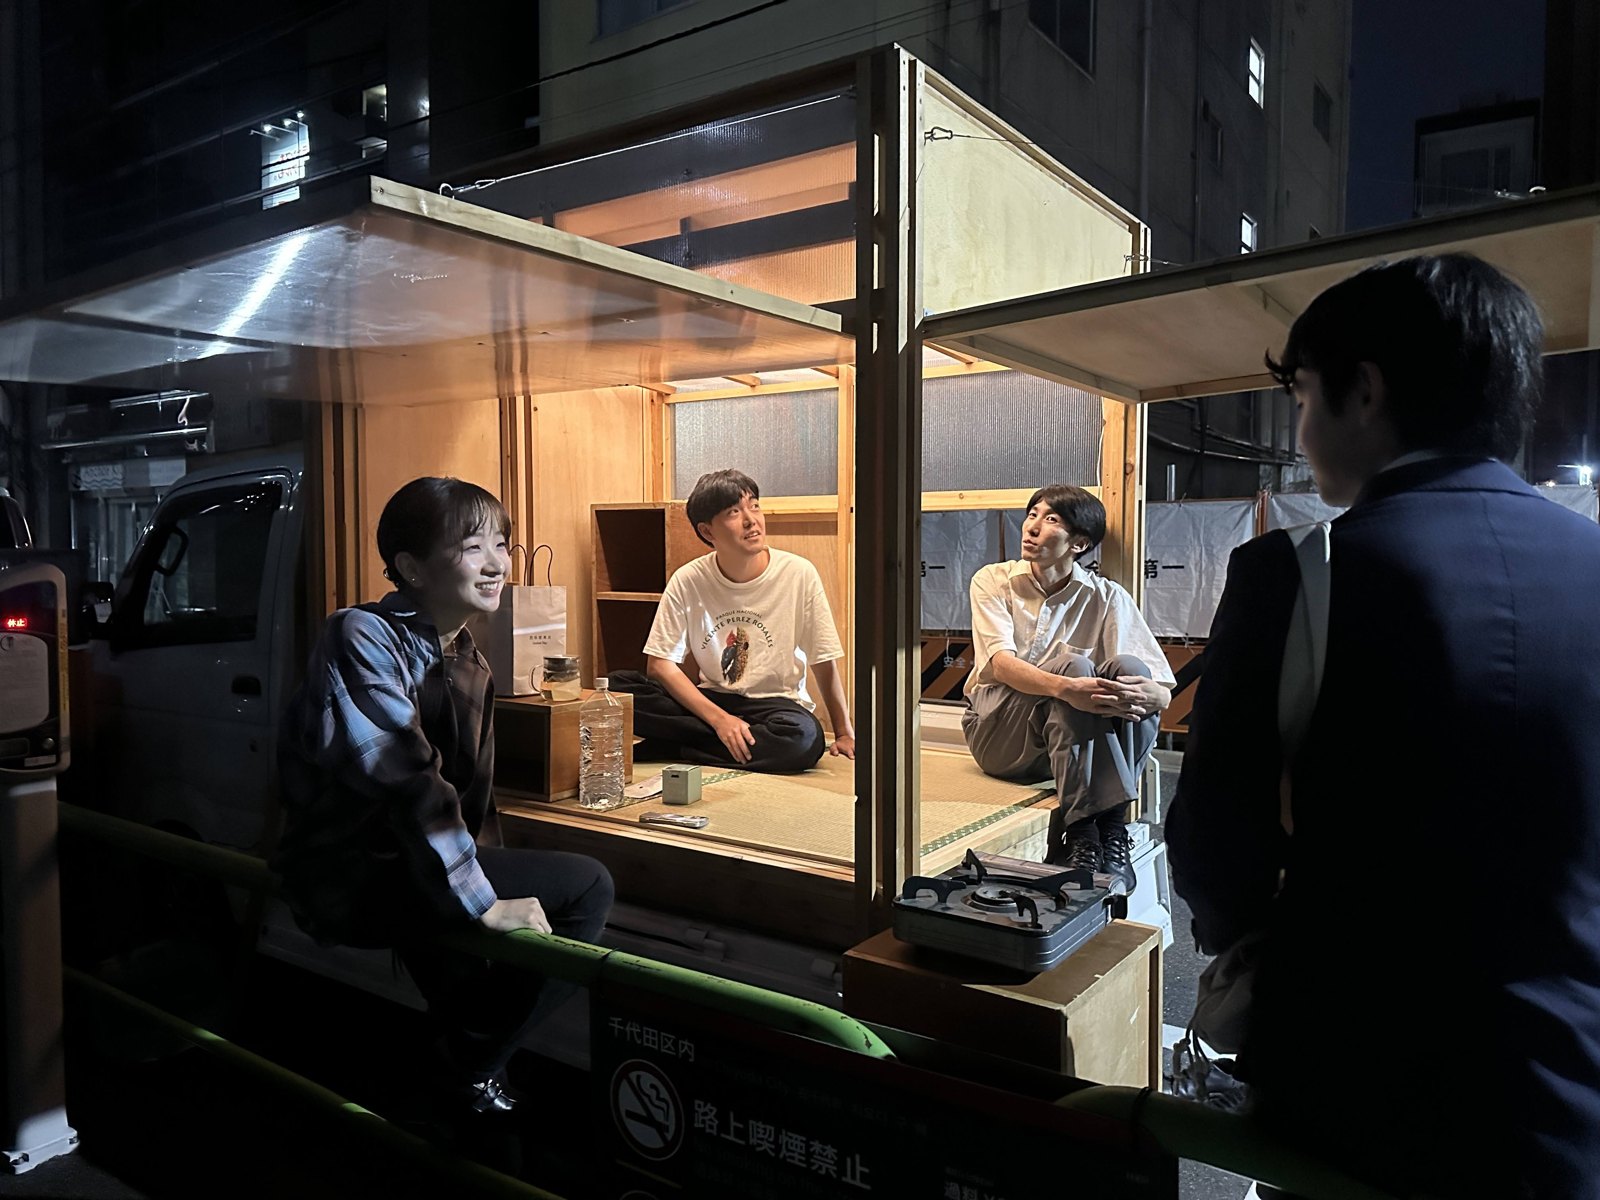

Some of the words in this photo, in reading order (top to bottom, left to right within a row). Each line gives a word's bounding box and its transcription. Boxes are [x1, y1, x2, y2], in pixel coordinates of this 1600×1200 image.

[701, 621, 725, 650] VICENTE
[726, 616, 751, 625] PEREZ
[752, 620, 774, 648] ROSALES
[607, 1016, 696, 1063] 千代田区内
[693, 1099, 873, 1191] 路上喫煙禁止
